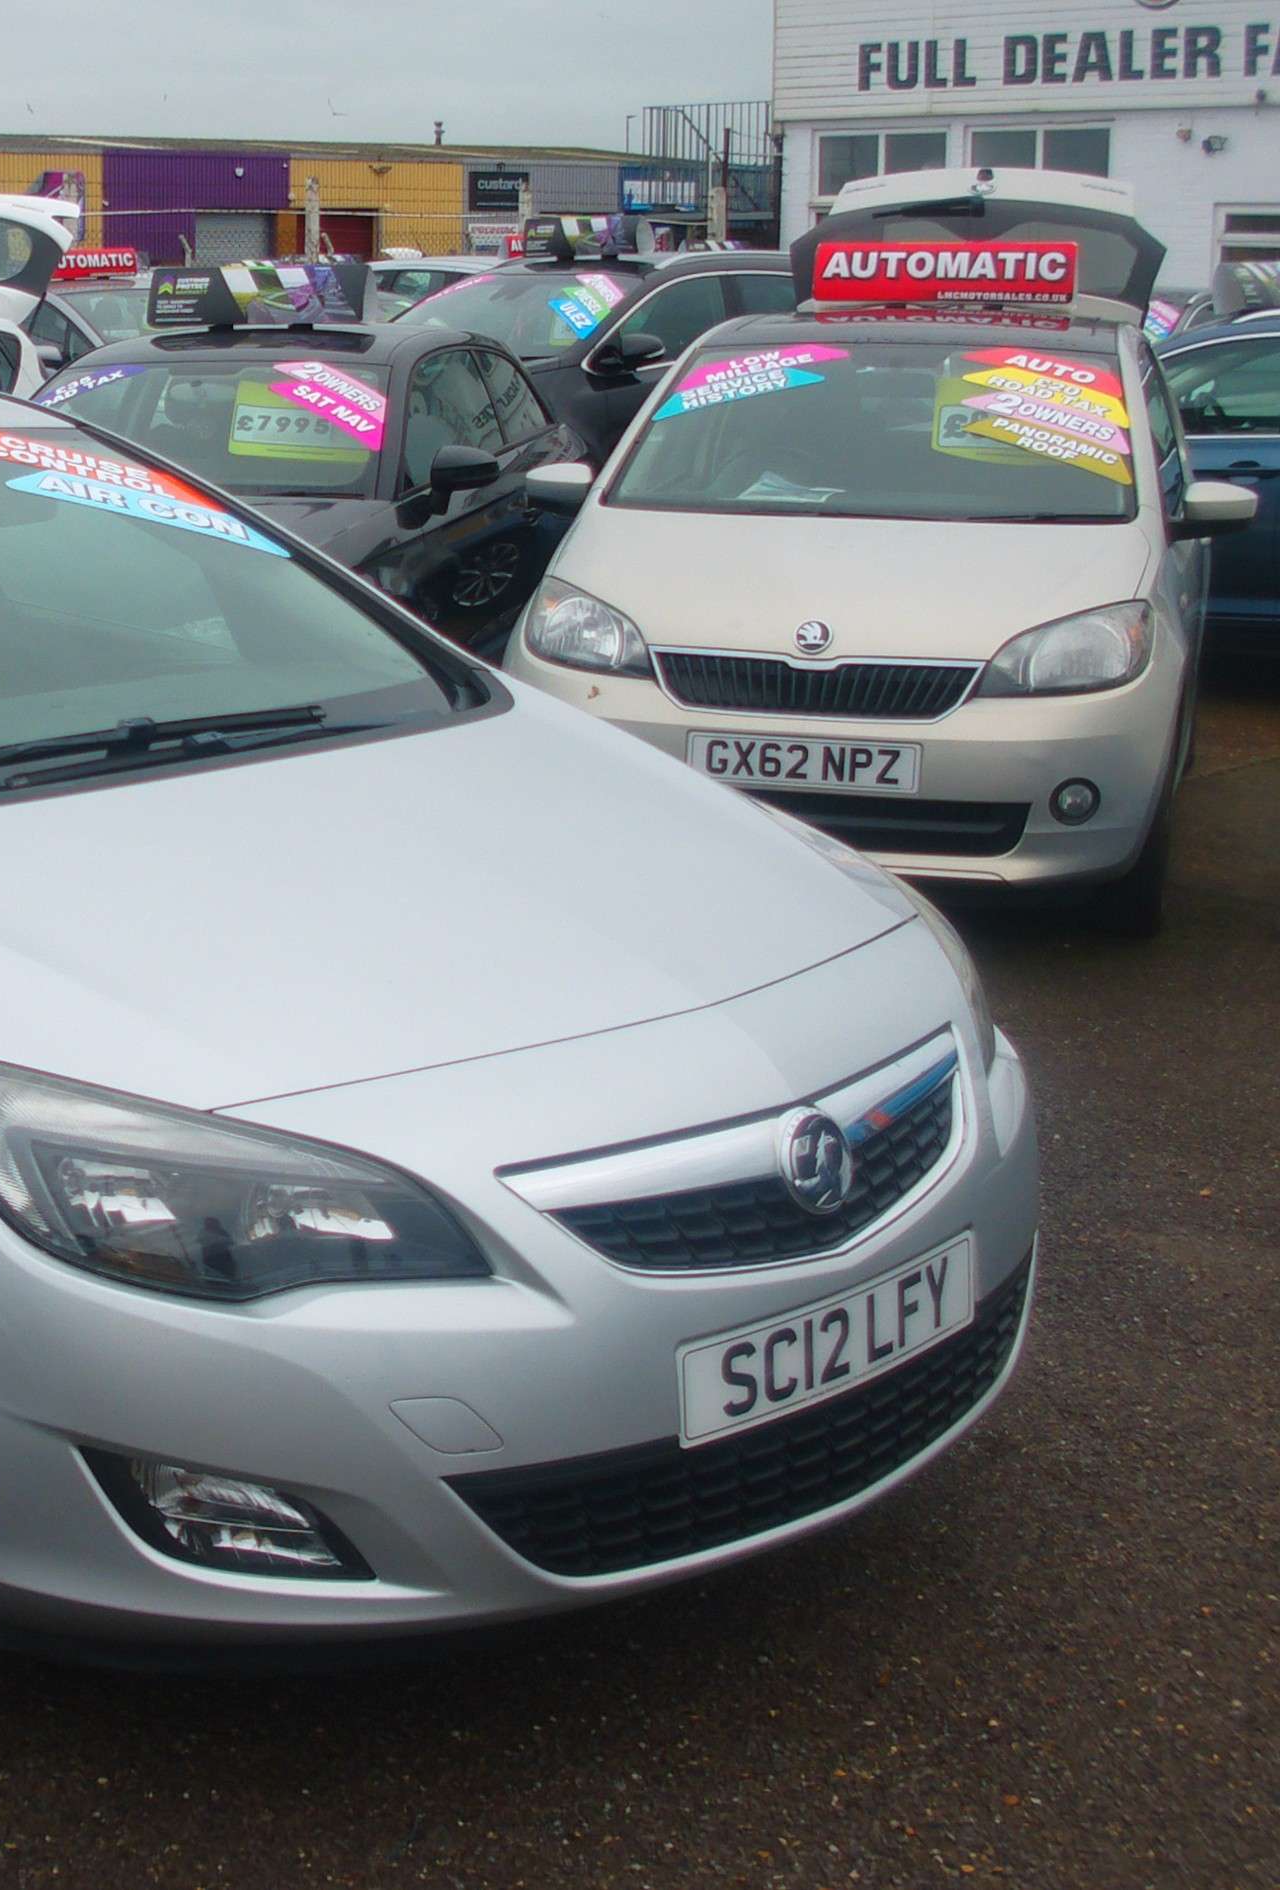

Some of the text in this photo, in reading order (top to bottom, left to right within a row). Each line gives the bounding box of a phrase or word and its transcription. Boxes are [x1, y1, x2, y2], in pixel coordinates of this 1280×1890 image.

[857, 23, 1280, 91] FULL DEALER F
[58, 253, 134, 268] UTOMATIC
[822, 251, 1068, 281] AUTOMATIC
[560, 302, 593, 329] ULEZ
[705, 354, 815, 383] MILEAGE
[729, 351, 780, 369] LOW
[1004, 354, 1096, 384] AUTO
[85, 369, 125, 389] TAX
[681, 370, 786, 400] SERVICE
[682, 378, 788, 410] HISTORY
[1034, 378, 1082, 397] £20
[292, 385, 376, 433] SAT NAV
[987, 376, 1111, 418] ROAD TAX
[236, 414, 331, 435] £7995
[991, 417, 1119, 465] PANORAMIC
[1016, 435, 1082, 461] ROOF
[0, 436, 152, 481] CRUISE
[39, 477, 251, 540] AIR CON
[705, 739, 902, 786] GX62 NPZ
[721, 1255, 948, 1418] SC12 LFY
